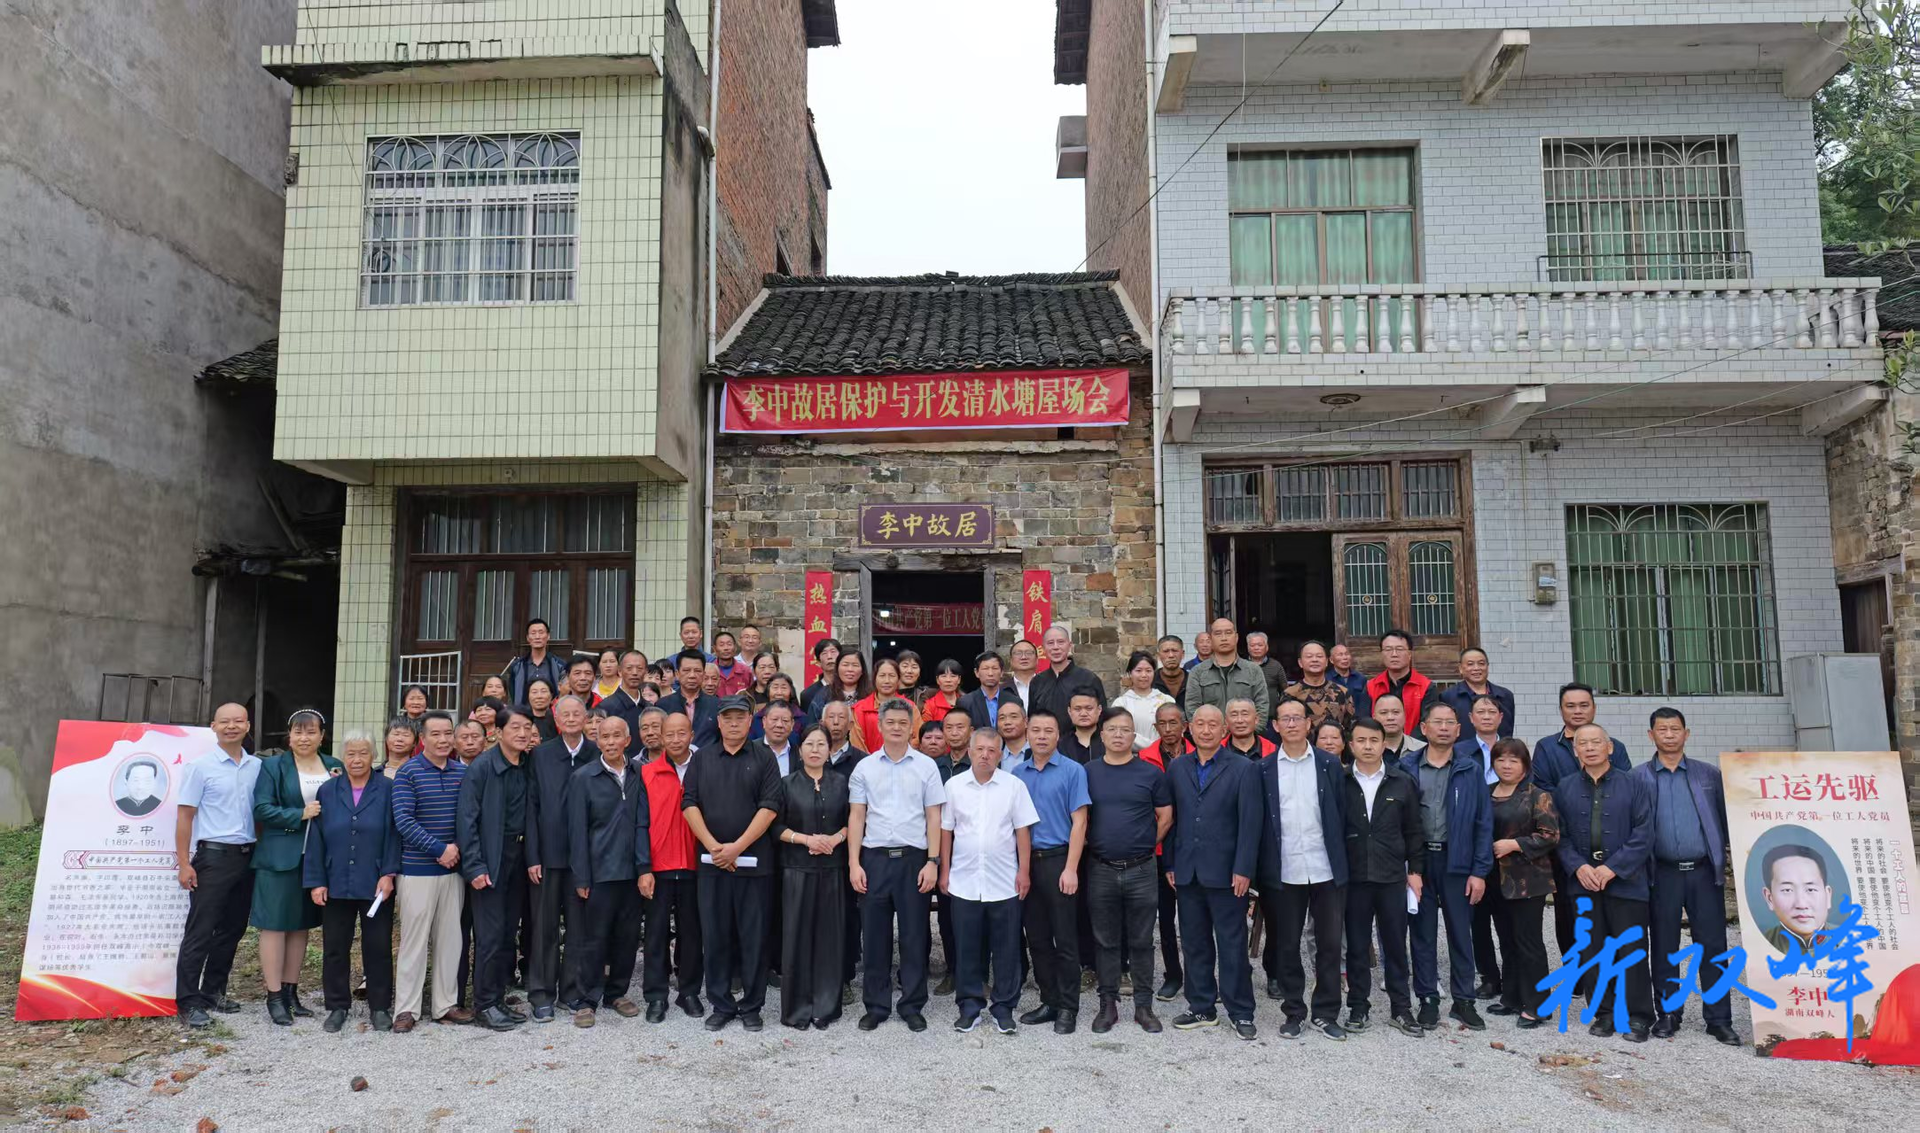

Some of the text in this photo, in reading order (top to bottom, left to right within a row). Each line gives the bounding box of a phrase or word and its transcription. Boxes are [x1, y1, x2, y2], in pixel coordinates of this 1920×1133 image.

[743, 376, 1110, 422] 李中故居保护与开发清水塘屋场会
[876, 511, 978, 540] 李中故居
[1751, 773, 1880, 801] 工运先驱
[1750, 811, 1890, 821] 中国共产党第一位工人党员
[1787, 986, 1828, 1006] 李中
